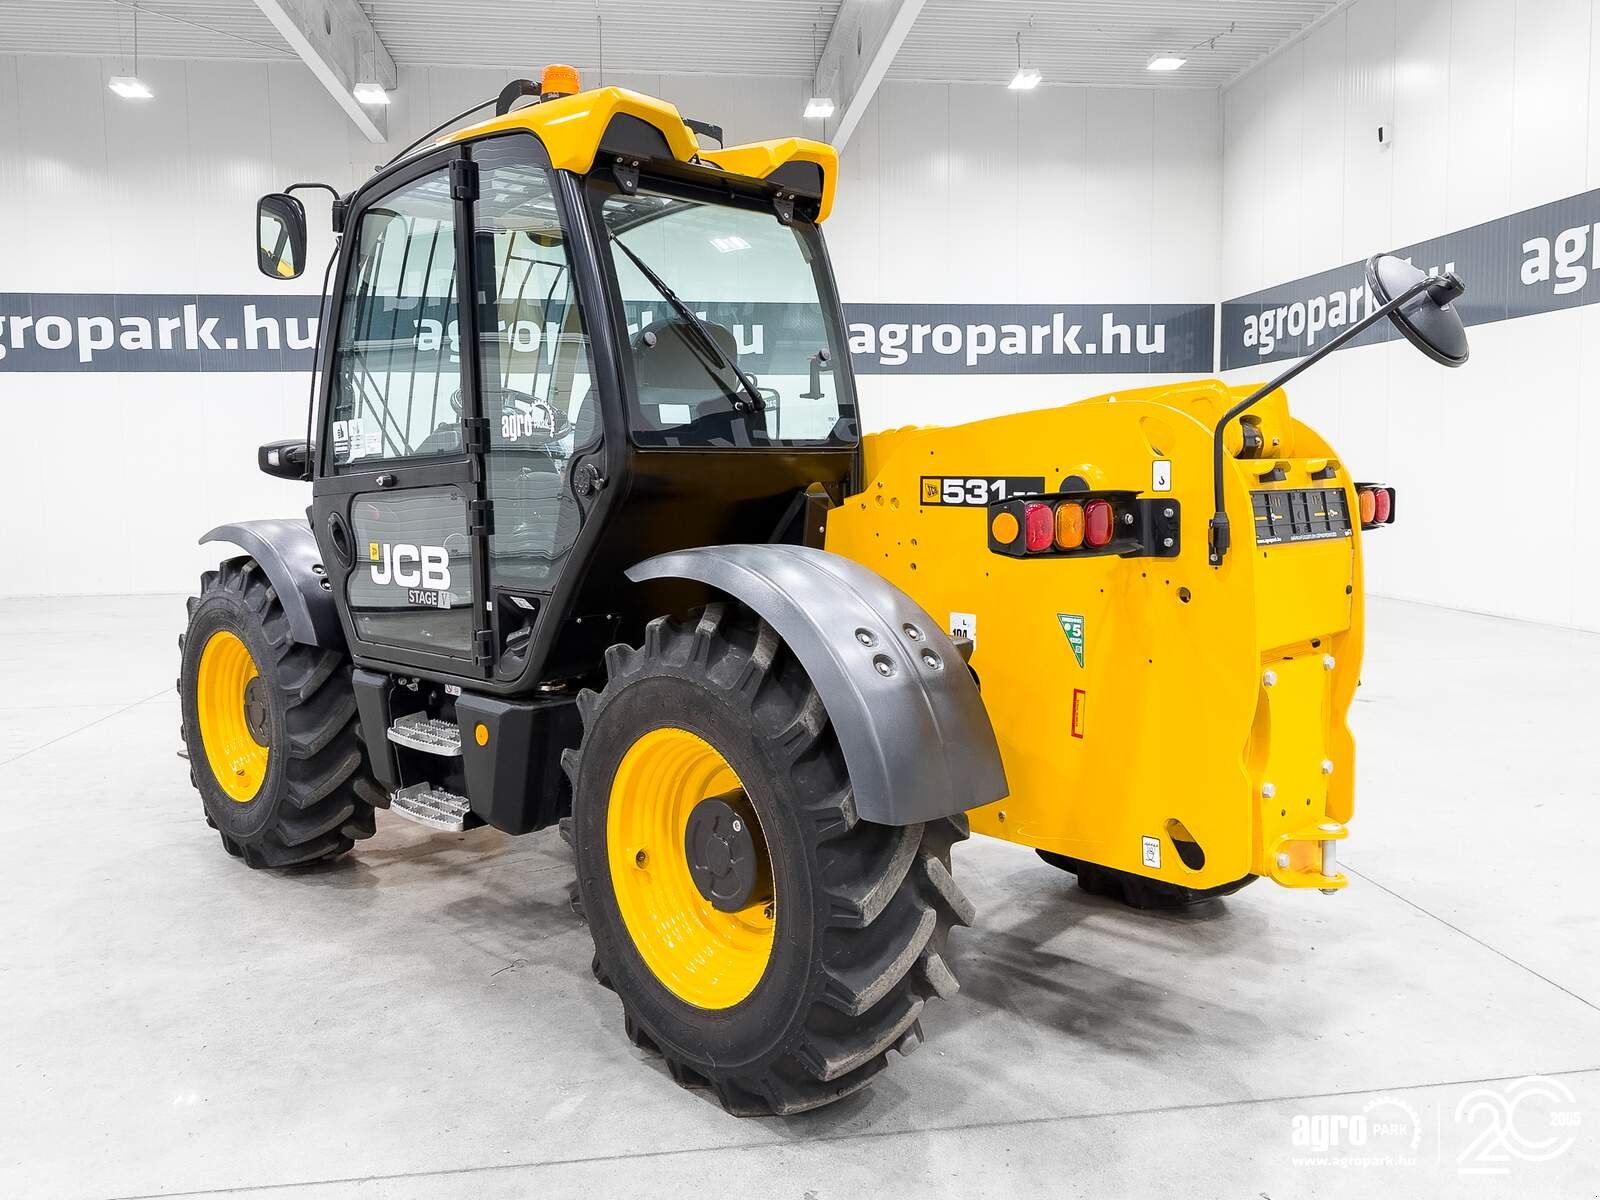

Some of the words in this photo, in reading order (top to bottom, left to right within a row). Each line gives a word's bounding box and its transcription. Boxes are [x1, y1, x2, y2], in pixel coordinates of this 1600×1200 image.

[0, 304, 321, 363] ropark.hu
[848, 312, 1166, 366] agropark.hu
[501, 413, 533, 441] agro
[370, 543, 451, 590] JCB
[408, 590, 437, 605] STAGE
